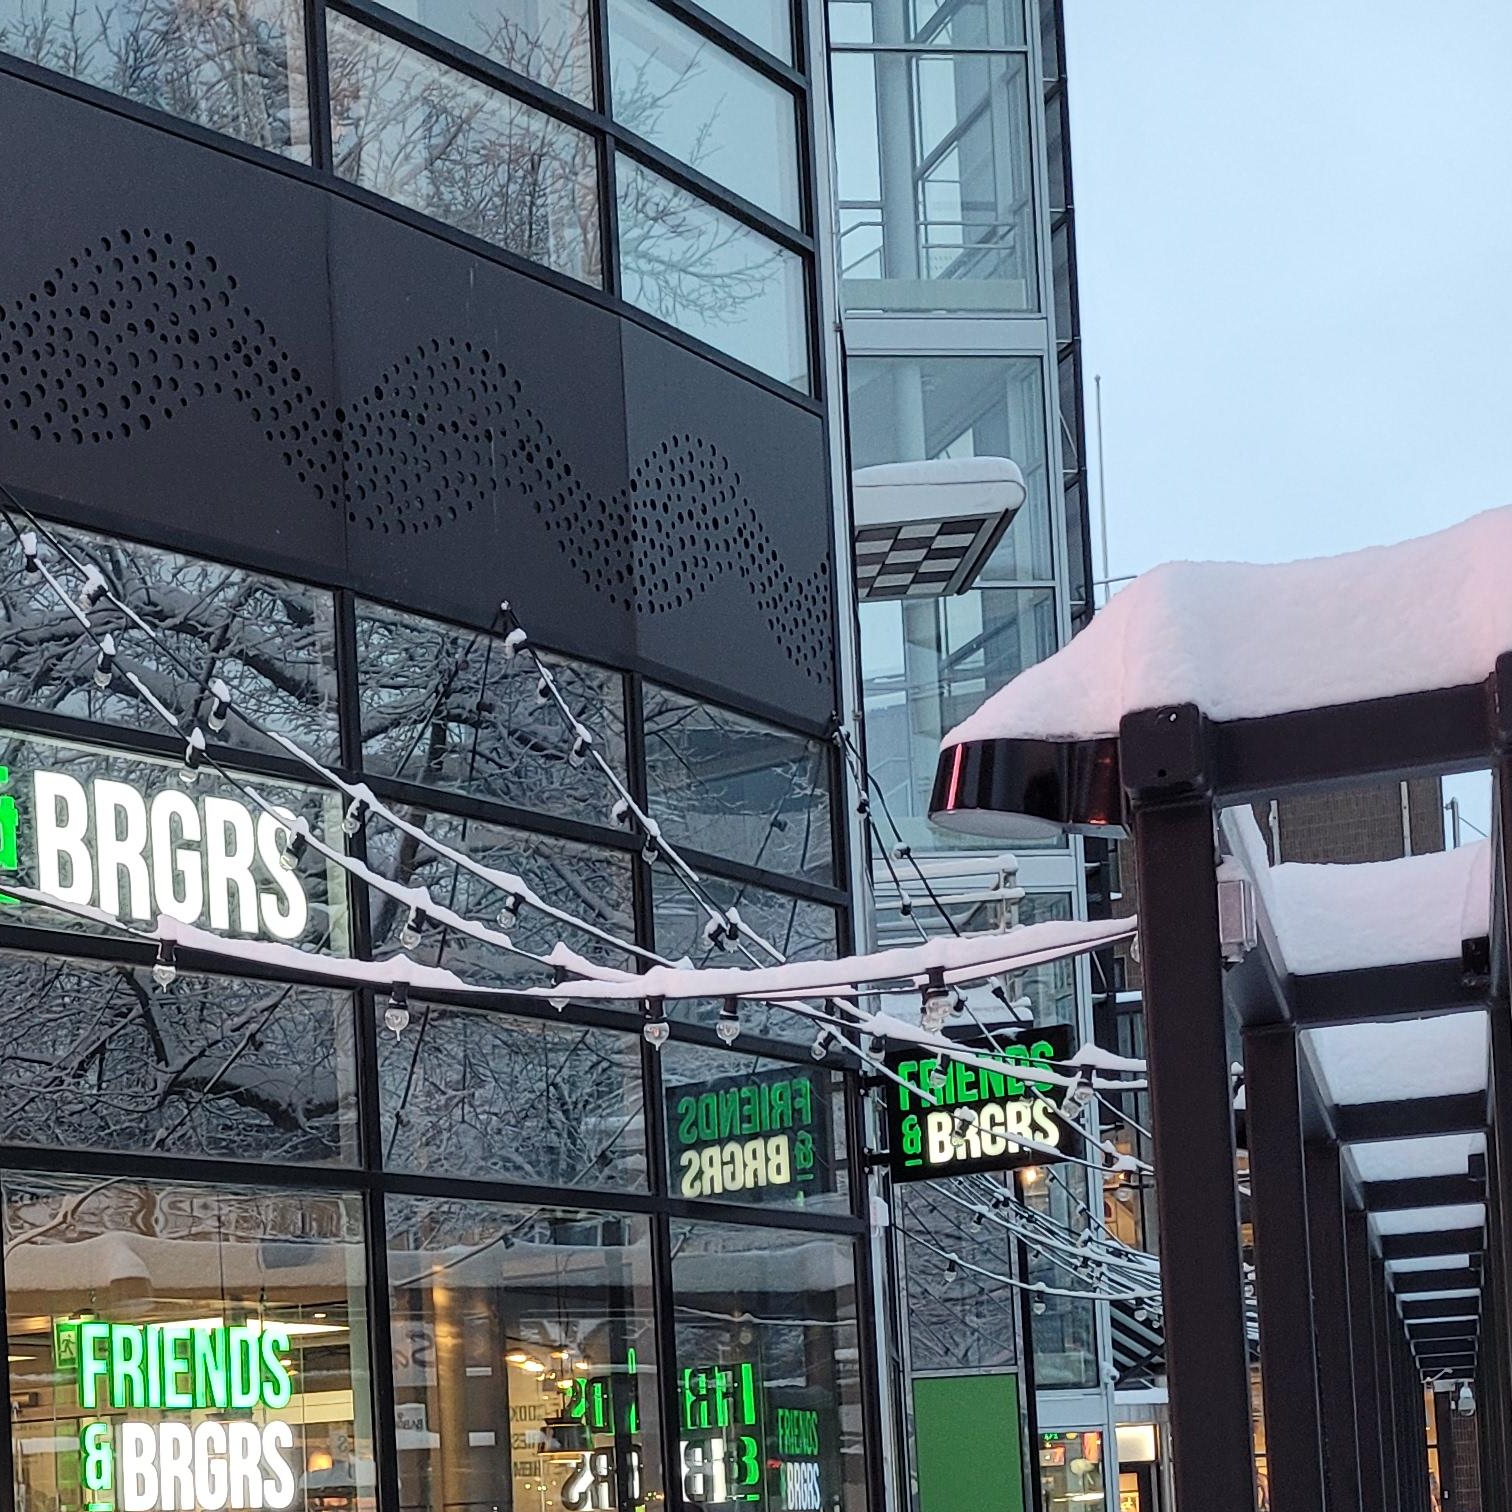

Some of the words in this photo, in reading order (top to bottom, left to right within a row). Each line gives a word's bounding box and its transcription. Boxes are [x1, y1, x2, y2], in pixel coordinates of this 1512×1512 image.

[33, 769, 308, 940] BRGRS
[902, 1114, 922, 1166] &
[78, 1323, 292, 1408] FRIENDS
[80, 1422, 113, 1511] &
[122, 1420, 295, 1511] BRGRS
